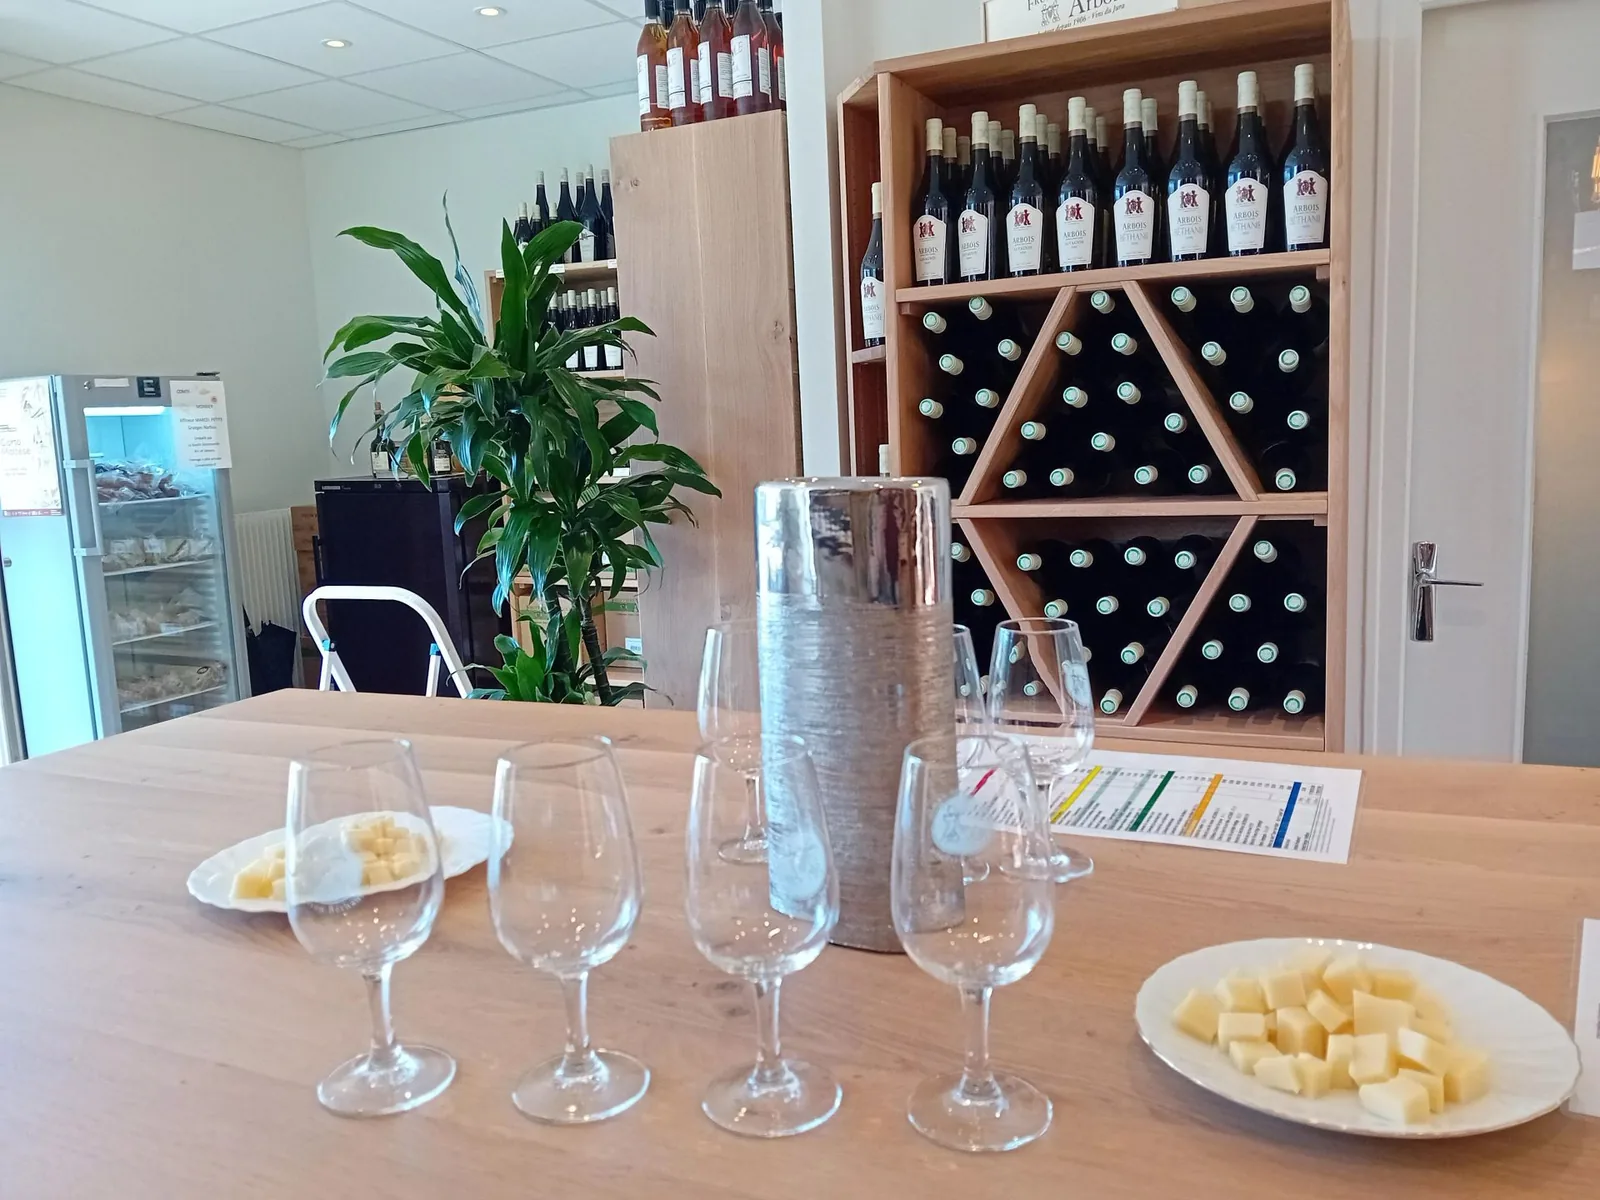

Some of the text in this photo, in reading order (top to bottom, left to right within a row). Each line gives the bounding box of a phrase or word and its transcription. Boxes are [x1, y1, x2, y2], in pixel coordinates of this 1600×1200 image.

[1068, 0, 1119, 18] Arbo
[1073, 16, 1087, 26] 1906
[1091, 11, 1104, 20] Vins
[1104, 7, 1112, 15] du
[1112, 3, 1126, 14] Jura
[1293, 203, 1320, 213] ARBOIS
[1233, 210, 1260, 219] ARBOIS
[1177, 216, 1202, 225] ARBOIS
[1122, 222, 1147, 230] ARBOIS
[1063, 230, 1087, 238] ARBOIS
[1013, 236, 1035, 244] ARBOIS
